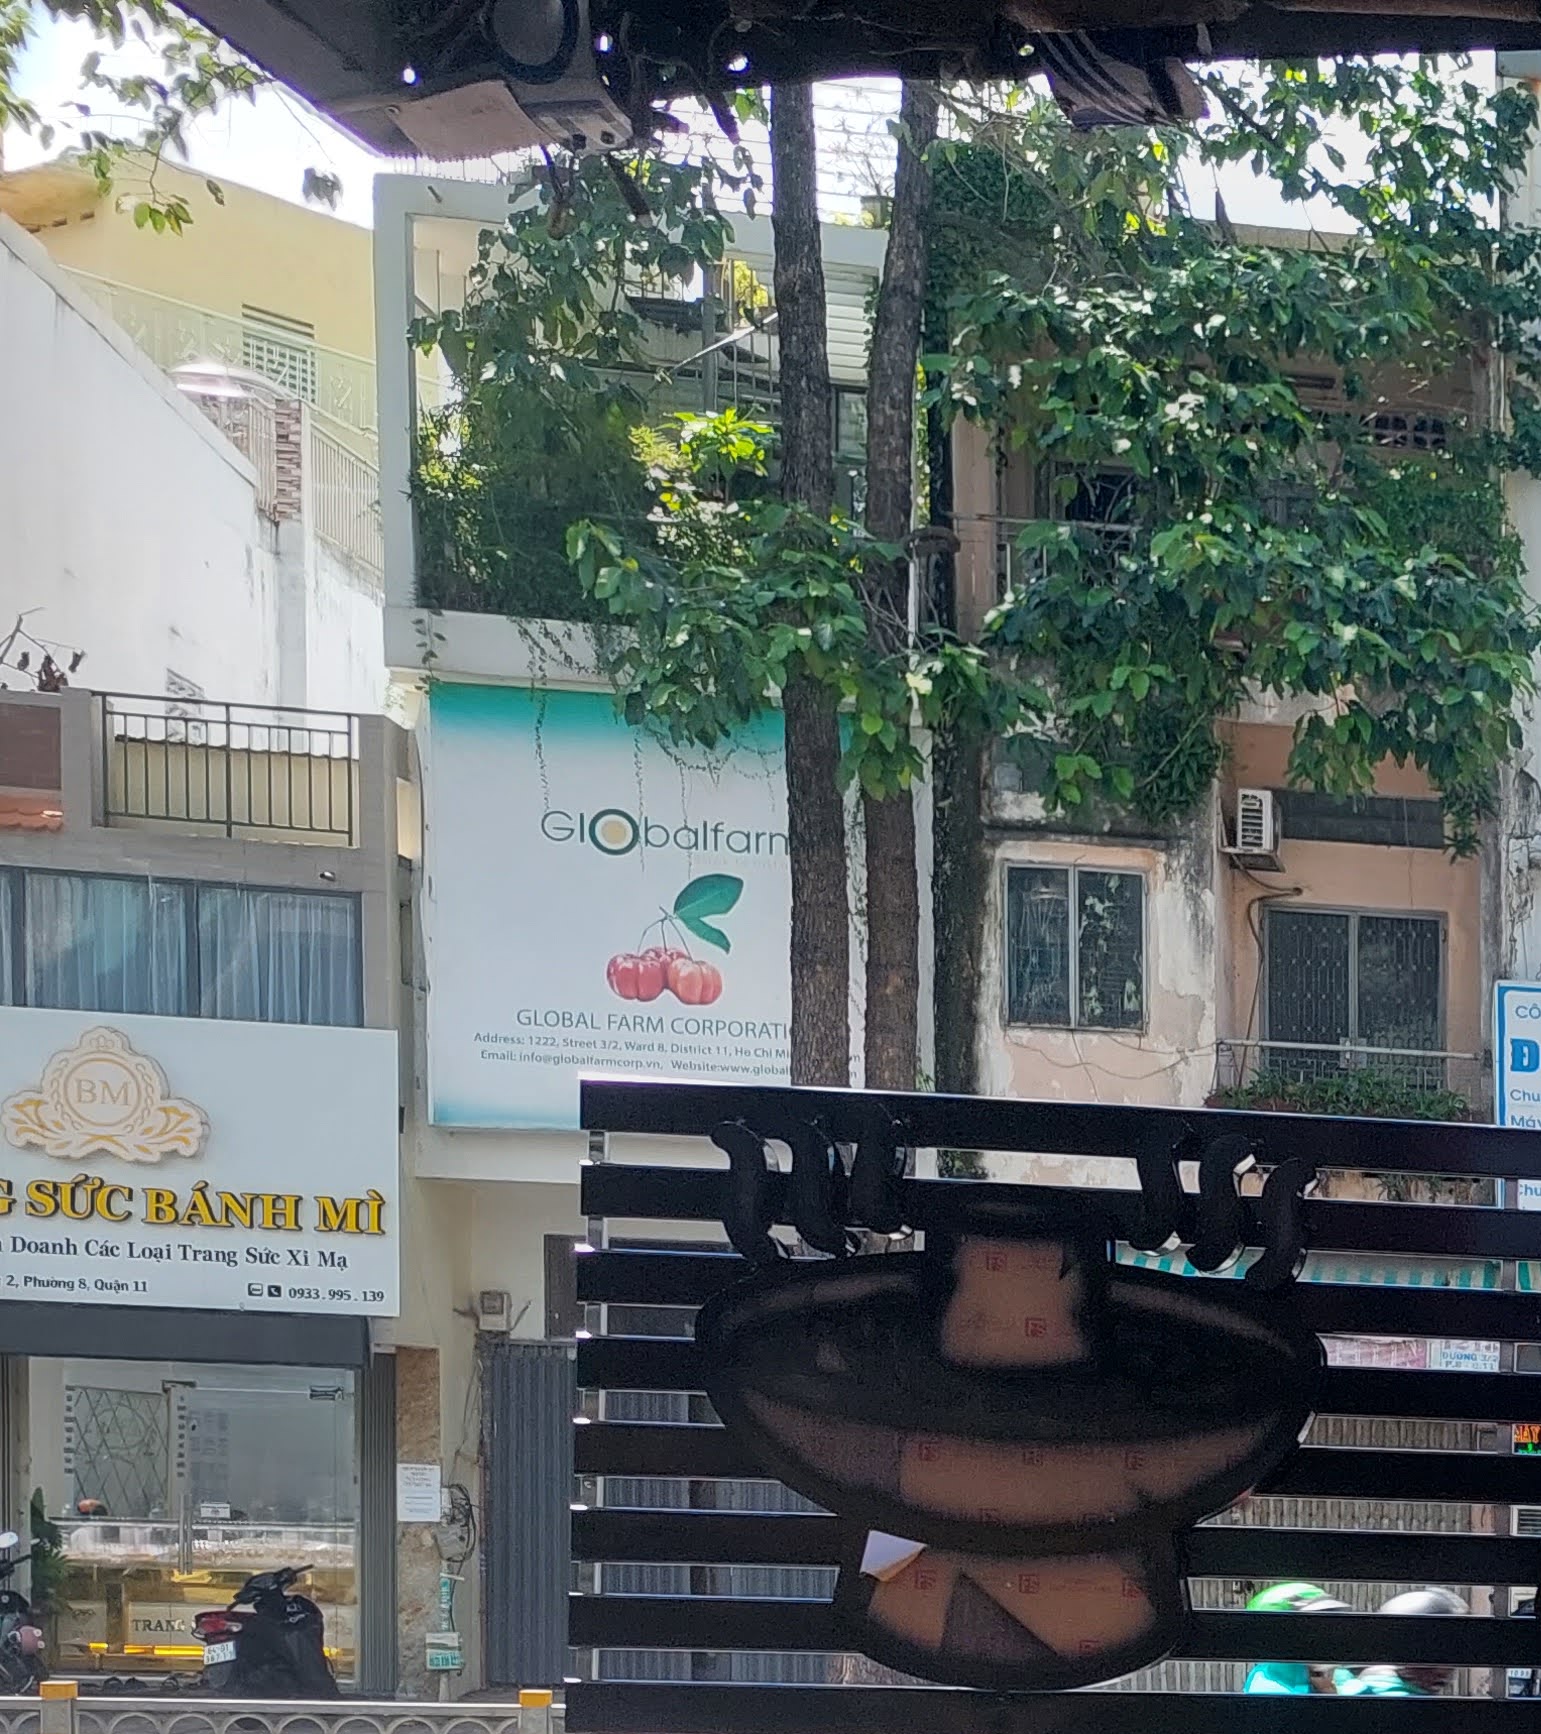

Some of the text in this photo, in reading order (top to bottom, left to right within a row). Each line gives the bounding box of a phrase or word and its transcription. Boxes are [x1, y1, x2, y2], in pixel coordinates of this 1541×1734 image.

[516, 1009, 791, 1040] GLOBAL FARM CORPORATI
[474, 1032, 525, 1045] Address:
[562, 1038, 598, 1050] Street
[625, 1041, 655, 1053] Ward
[671, 1043, 713, 1055] District
[754, 1047, 773, 1059] Chi
[775, 1048, 791, 1060] Mi
[480, 1050, 517, 1062] Email:
[74, 1077, 132, 1107] BM
[25, 1173, 133, 1221] SỨC
[142, 1180, 304, 1232] BÁNH
[313, 1188, 386, 1236] MÌ
[10, 1236, 78, 1256] Doanh
[84, 1238, 121, 1258] Các
[127, 1241, 173, 1263] Loại
[178, 1243, 239, 1268] Trang
[245, 1246, 281, 1266] Sức
[317, 1250, 349, 1272] Mạ
